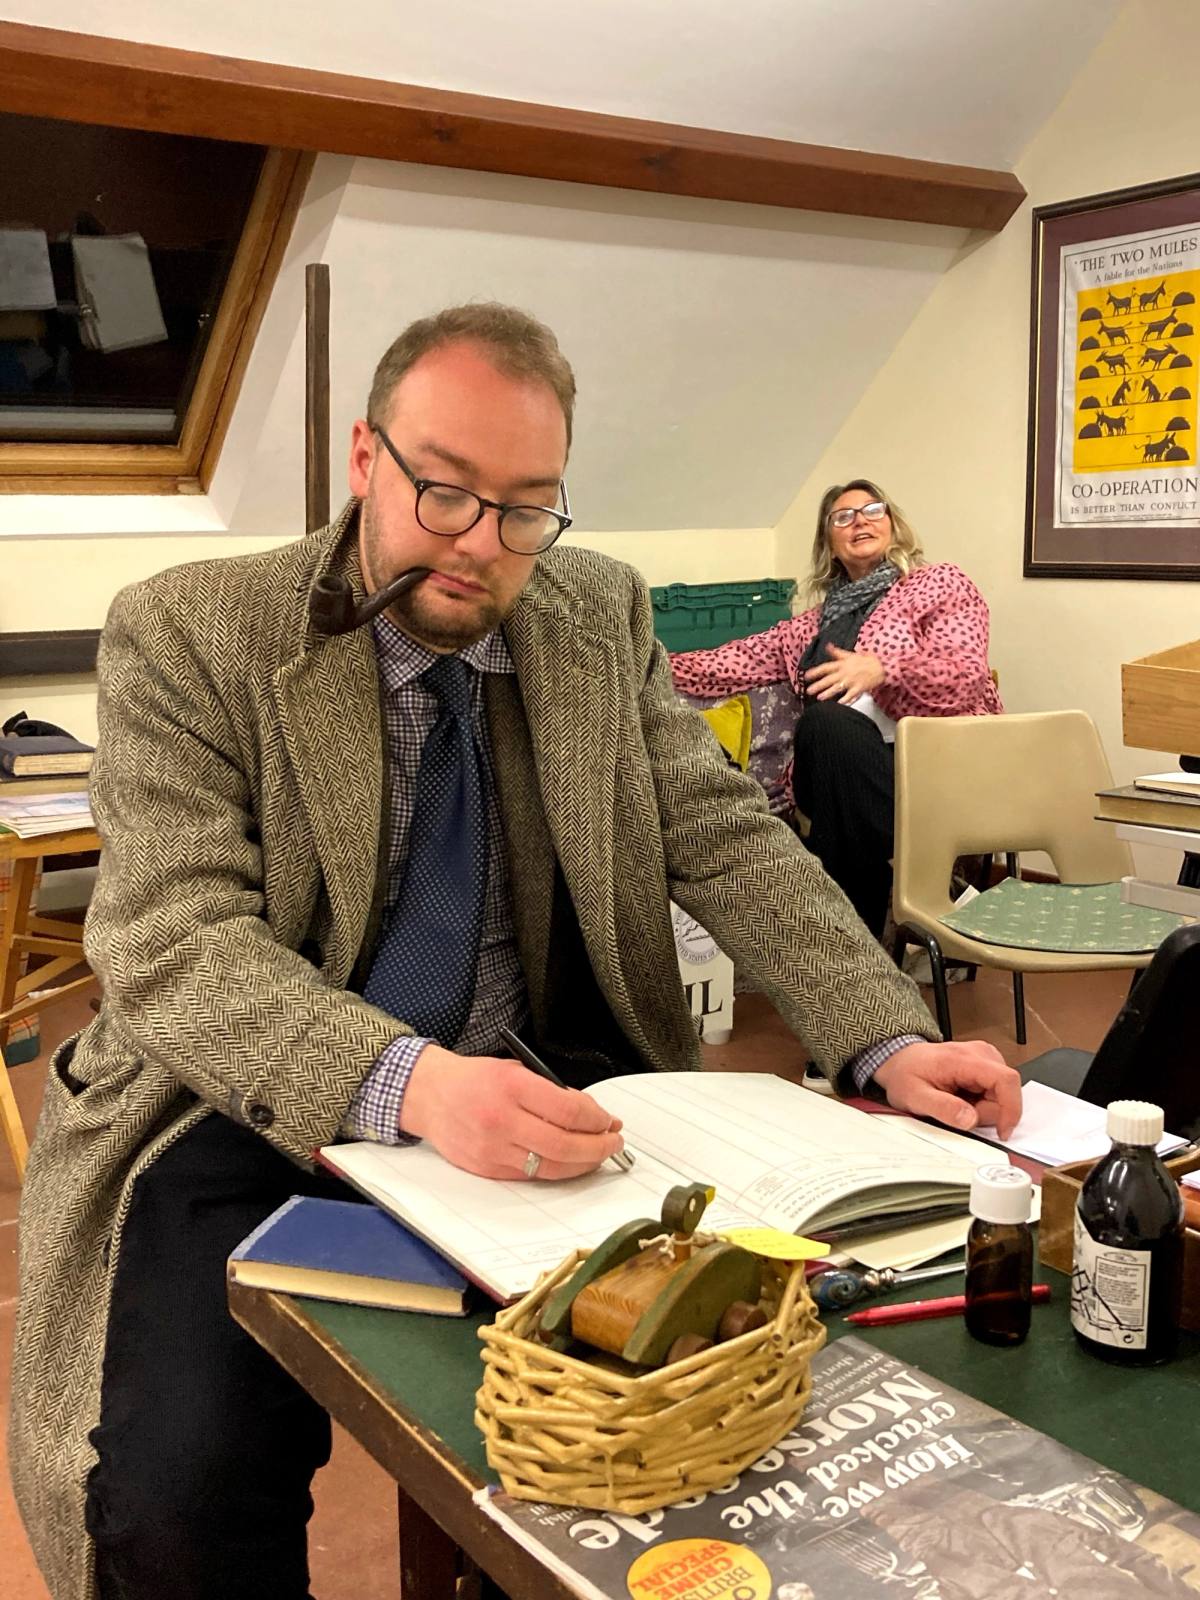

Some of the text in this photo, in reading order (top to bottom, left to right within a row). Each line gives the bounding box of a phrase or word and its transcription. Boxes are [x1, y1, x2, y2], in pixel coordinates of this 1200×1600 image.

[1080, 237, 1198, 272] THE TWO MULES
[1125, 268, 1135, 277] for
[1138, 265, 1149, 274] the
[1153, 260, 1183, 271] Nations
[1072, 477, 1198, 498] CO-OPERATION
[1071, 500, 1198, 514] IS BETTER THAN CONFLICT
[820, 1355, 855, 1377] short
[806, 1401, 956, 1491] cracked
[822, 1434, 975, 1518] How we
[721, 1479, 808, 1529] the
[631, 1541, 728, 1592] SPECIAL
[654, 1557, 733, 1600] CRIME
[677, 1566, 753, 1600] BRITIS
